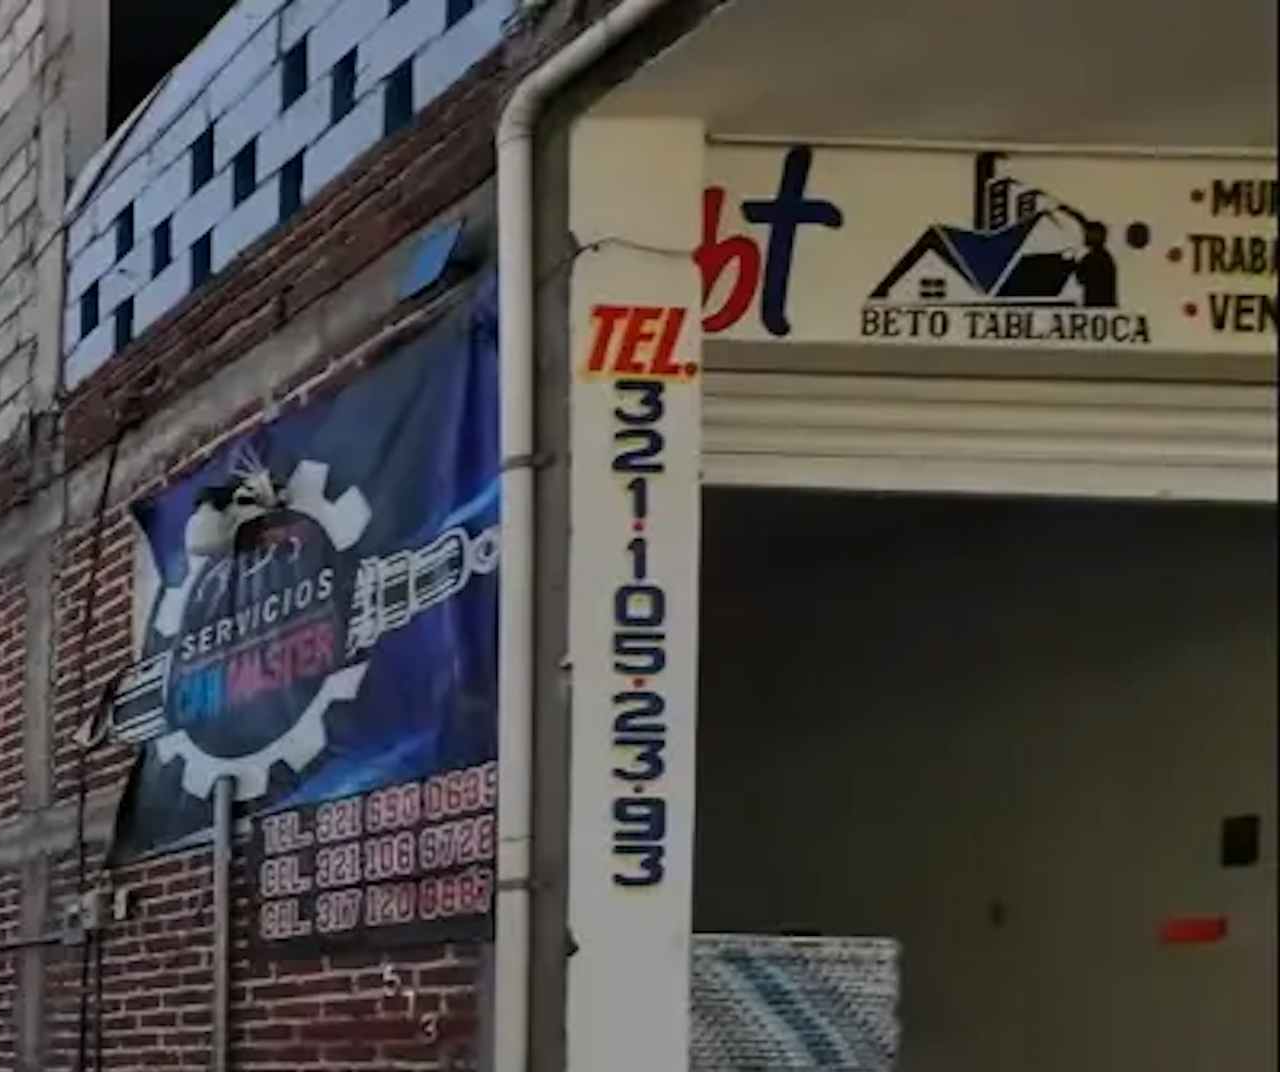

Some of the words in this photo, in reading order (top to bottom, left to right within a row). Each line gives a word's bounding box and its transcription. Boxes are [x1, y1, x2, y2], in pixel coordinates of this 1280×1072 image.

[1187, 232, 1278, 276] TRAB
[587, 304, 698, 376] TEL.
[860, 308, 949, 338] BETO
[963, 309, 1151, 343] TABLAROCA
[179, 566, 335, 662] SERVICIOS
